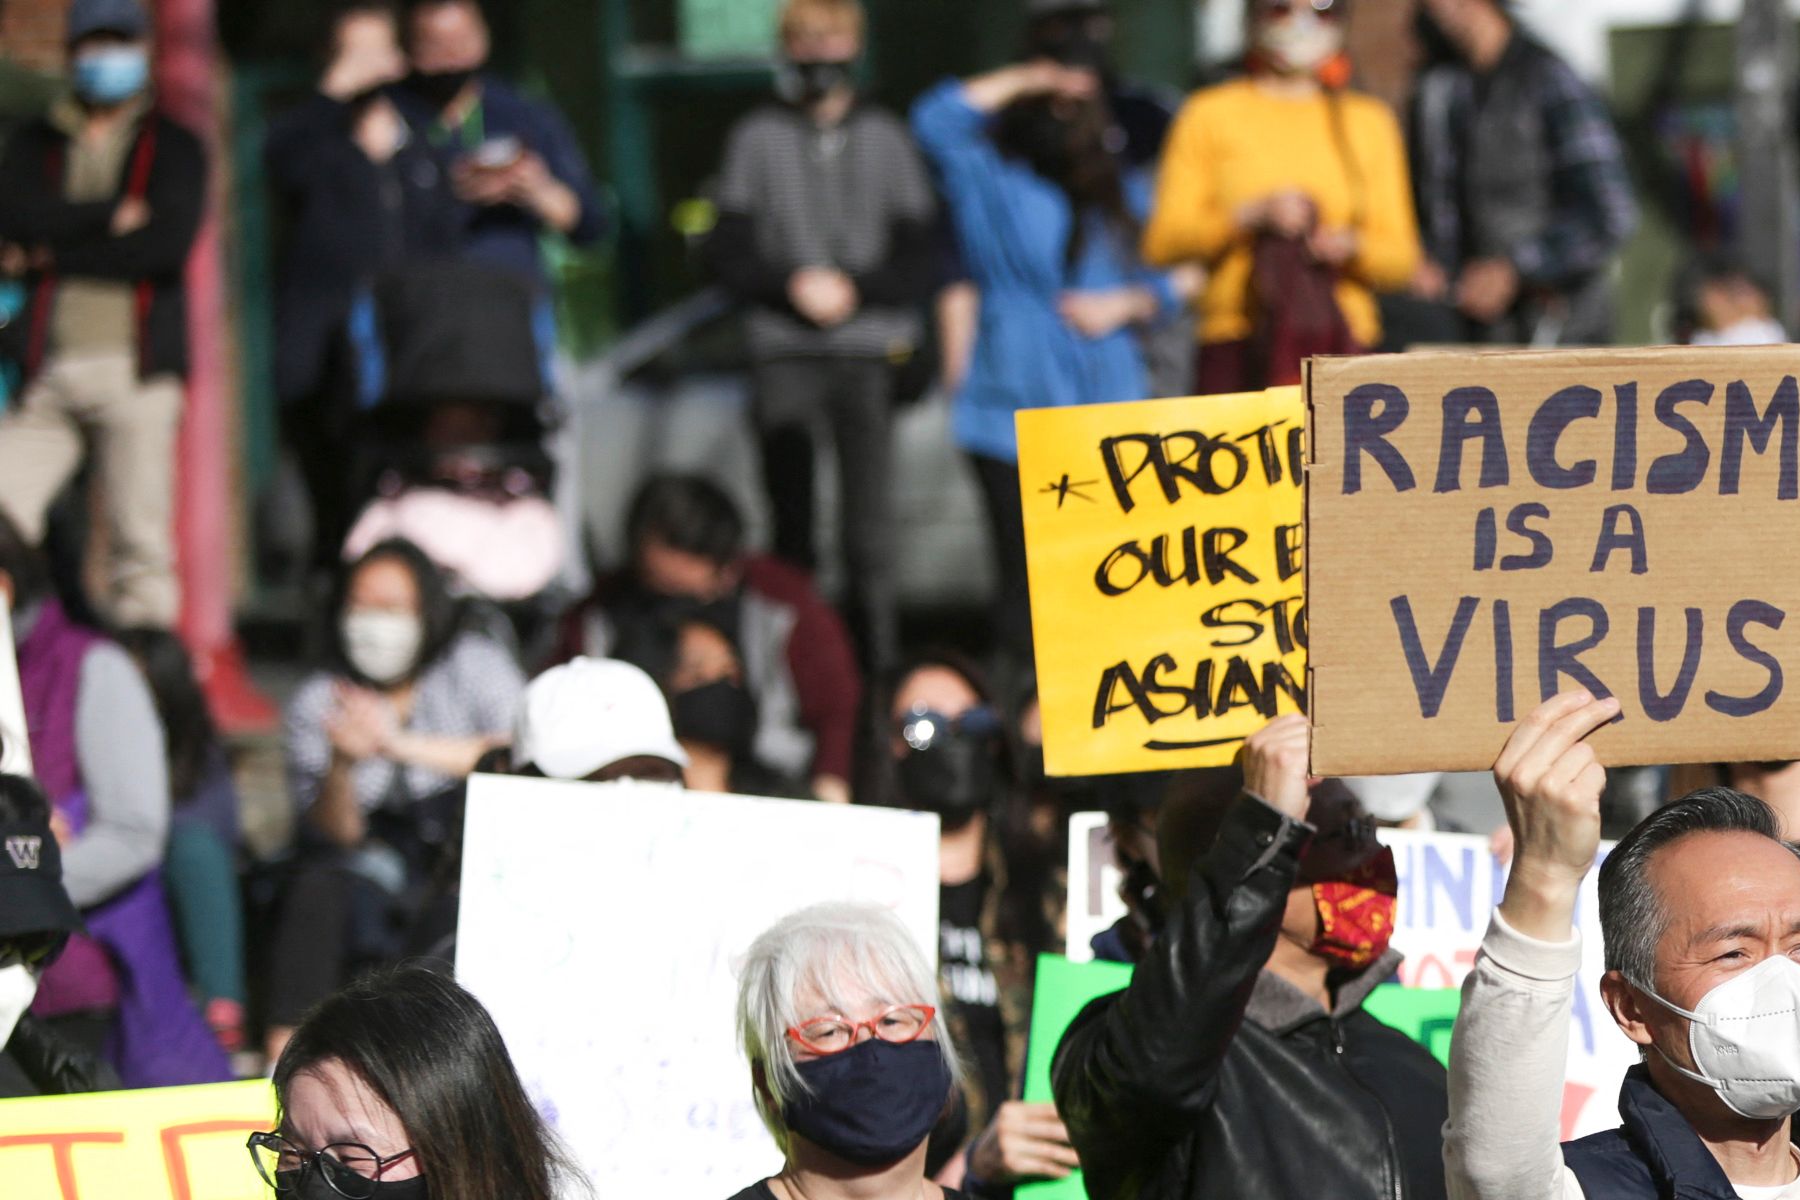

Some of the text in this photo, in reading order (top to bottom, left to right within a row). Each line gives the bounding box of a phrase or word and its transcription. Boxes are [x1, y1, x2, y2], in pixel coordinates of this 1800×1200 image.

[1342, 375, 1800, 500] RACISM
[1093, 524, 1260, 598] OUR
[1473, 503, 1648, 574] IS A
[1390, 595, 1786, 724] VIRUS
[5, 834, 42, 869] W
